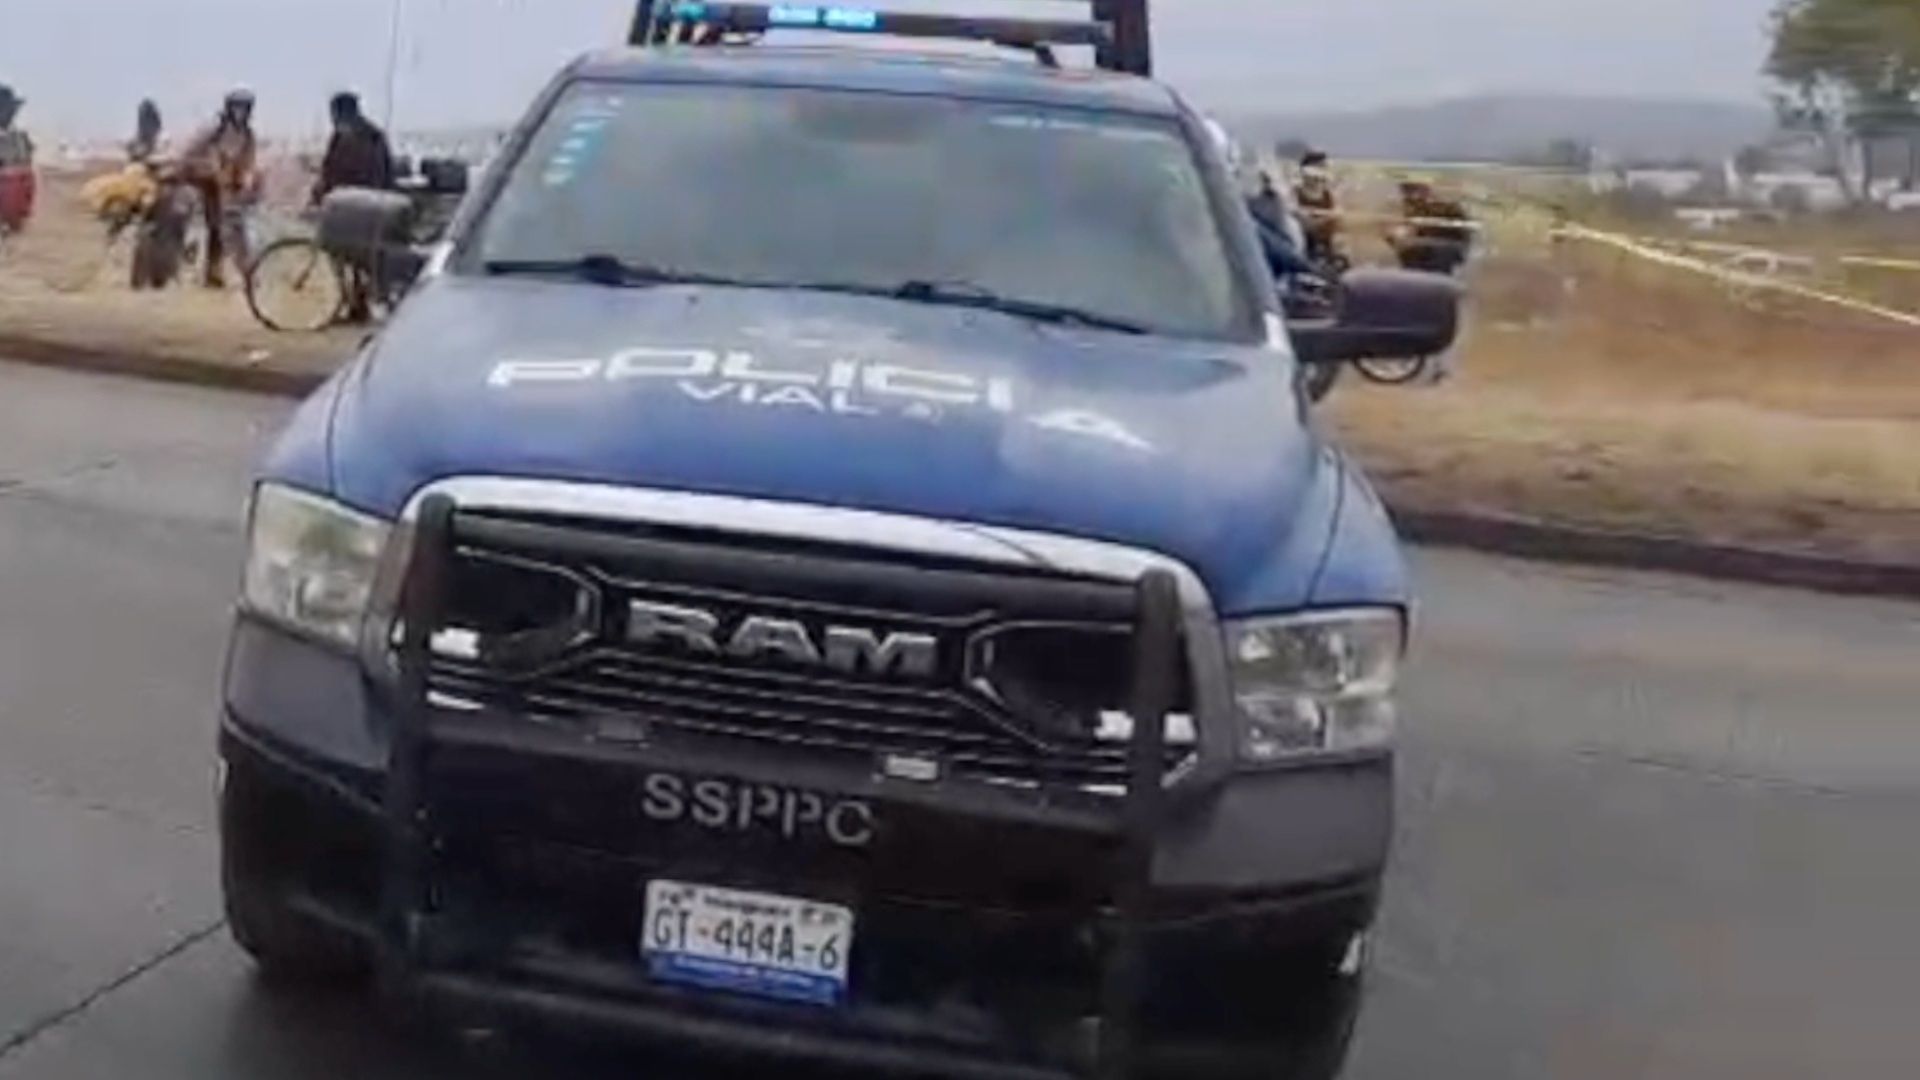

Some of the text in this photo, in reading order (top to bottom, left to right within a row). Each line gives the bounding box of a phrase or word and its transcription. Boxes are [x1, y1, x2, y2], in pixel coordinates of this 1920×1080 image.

[488, 347, 1151, 452] POLICIA
[678, 380, 881, 416] VIAL
[627, 597, 937, 677] RAM
[643, 772, 873, 845] SSPPC
[653, 906, 841, 971] GT-444A-6
